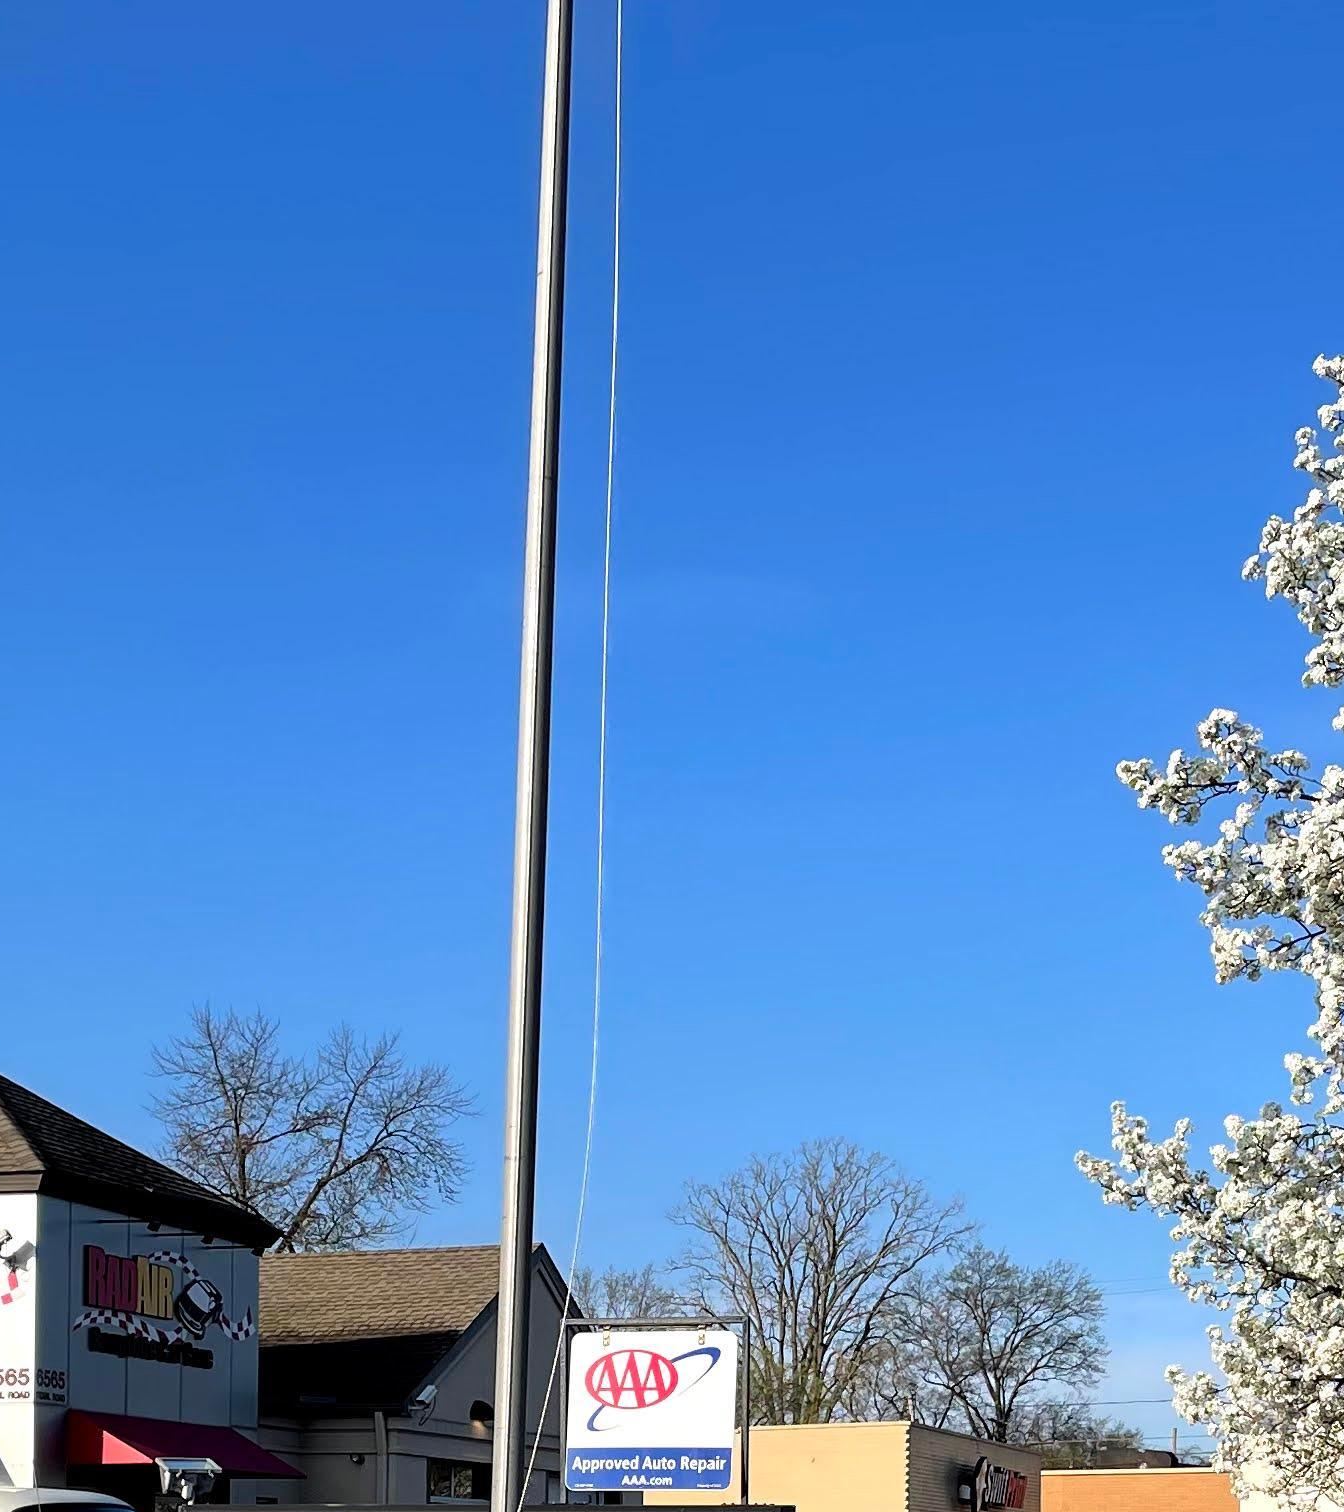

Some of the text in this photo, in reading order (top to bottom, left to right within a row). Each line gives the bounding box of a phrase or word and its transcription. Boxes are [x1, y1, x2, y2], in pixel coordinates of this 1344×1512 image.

[595, 1349, 669, 1409] AAA
[8, 1391, 31, 1400] ROAD
[572, 1456, 727, 1473] Approved Auto Repair
[621, 1475, 673, 1486] AAA.com
